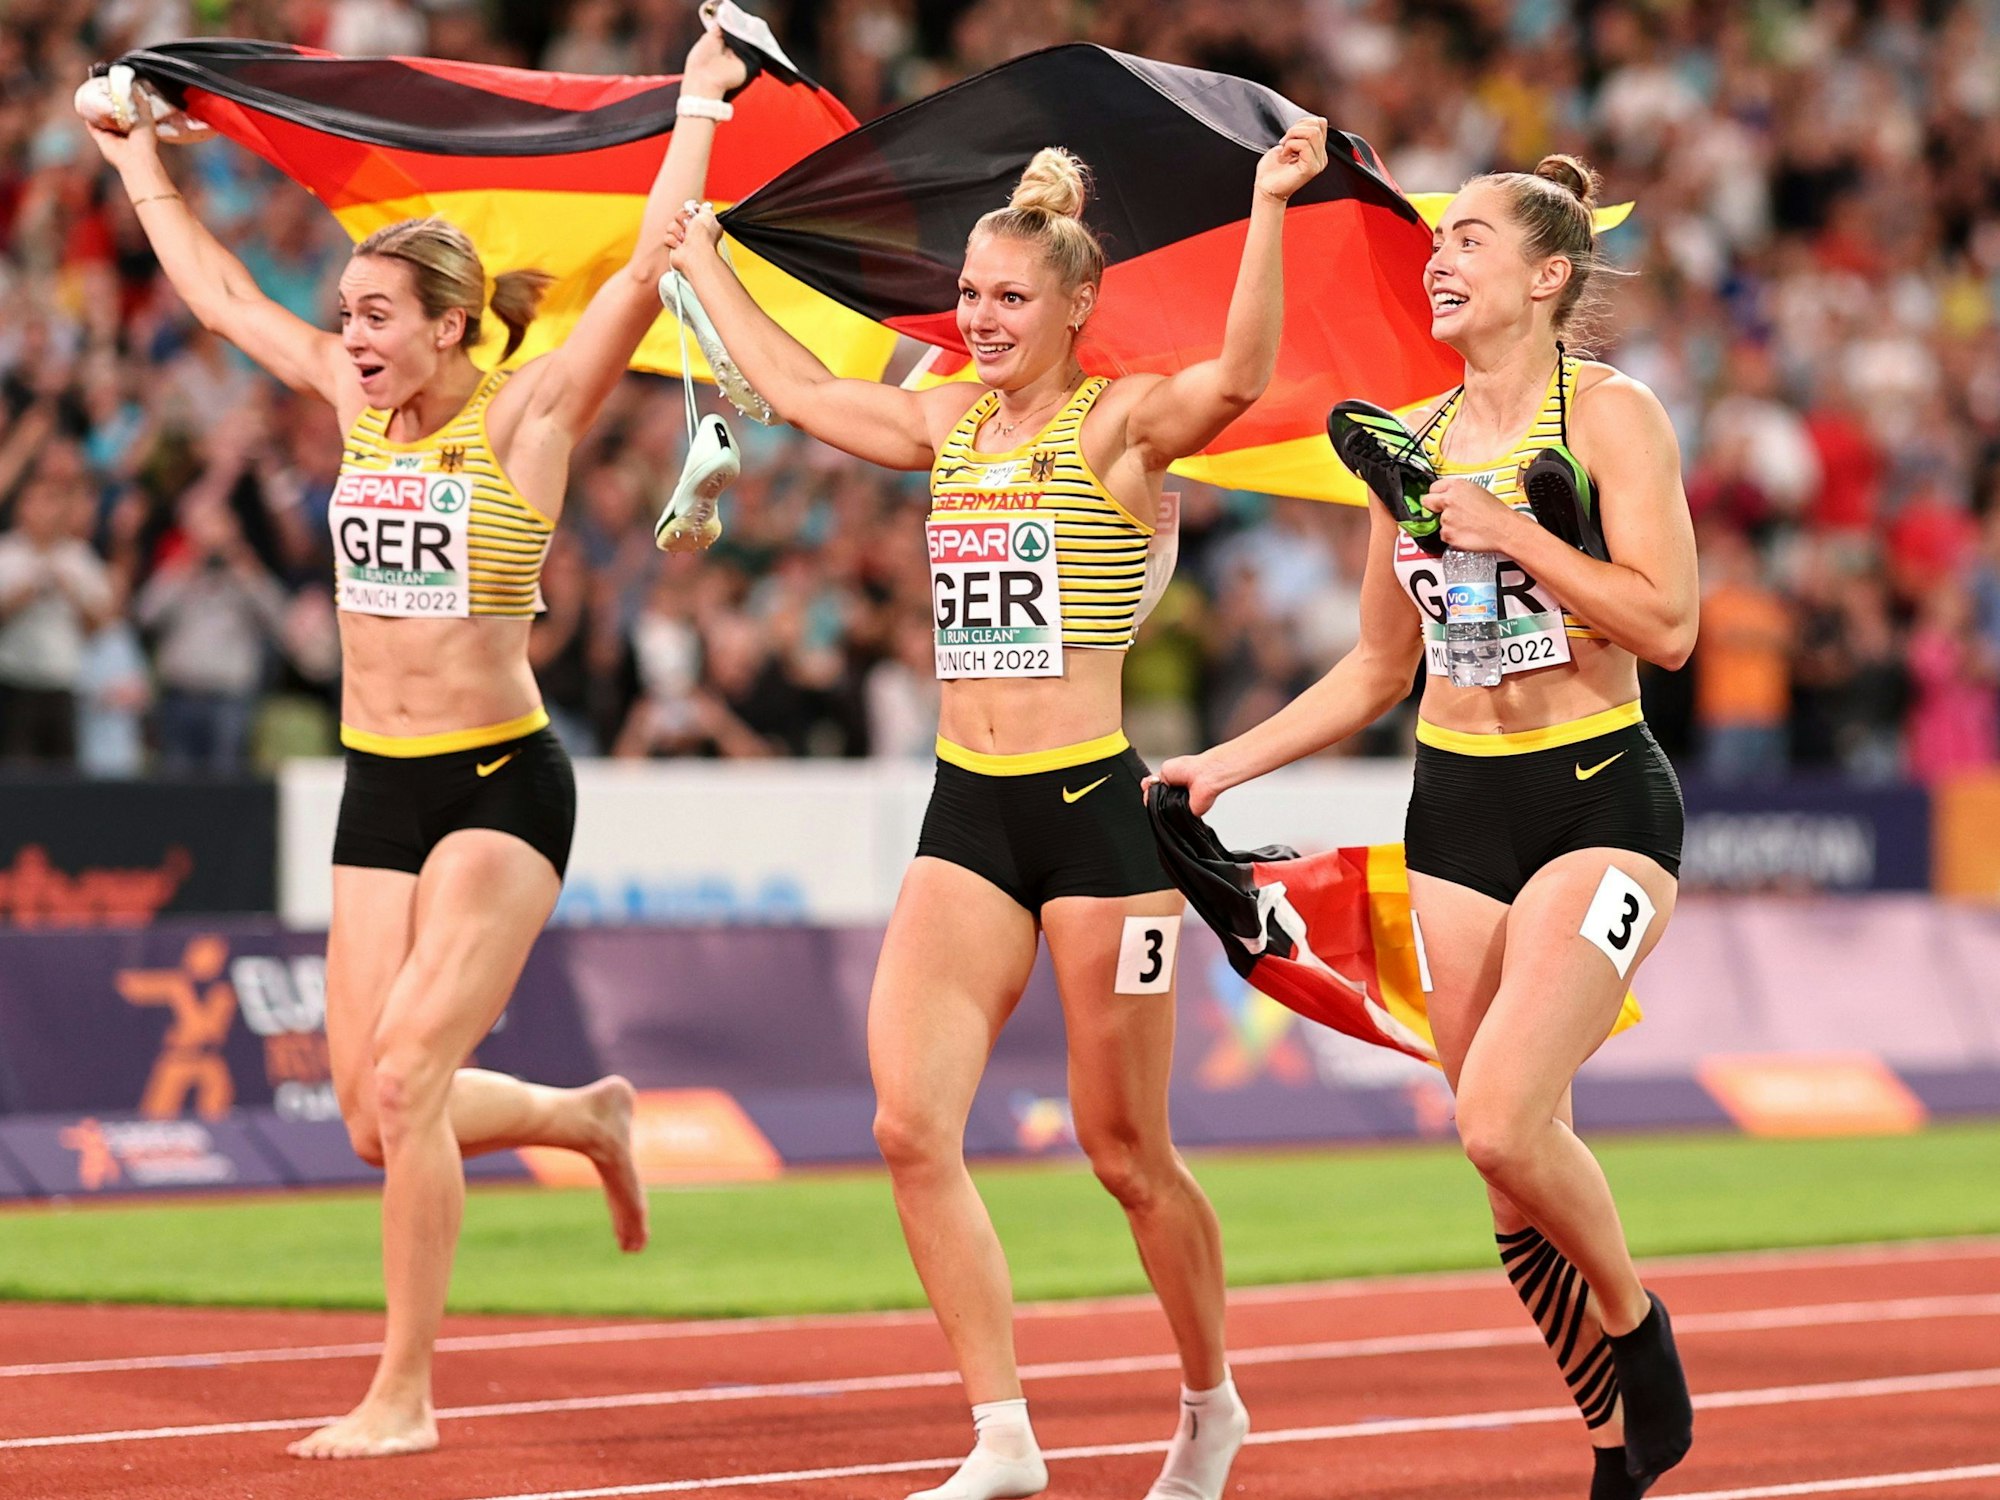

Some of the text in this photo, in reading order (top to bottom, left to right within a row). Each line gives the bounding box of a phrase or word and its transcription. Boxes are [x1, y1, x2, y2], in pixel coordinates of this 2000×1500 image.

[340, 478, 424, 507] SPAR
[936, 491, 1045, 510] GERMANY
[340, 517, 455, 571] GER
[928, 528, 1007, 559] SPAR
[404, 591, 457, 610] 2022
[935, 571, 1048, 630] GER
[1409, 560, 1548, 625] GR
[947, 630, 969, 644] RUN
[993, 649, 1050, 670] 2022
[1606, 892, 1640, 951] 3
[1139, 929, 1164, 984] 3
